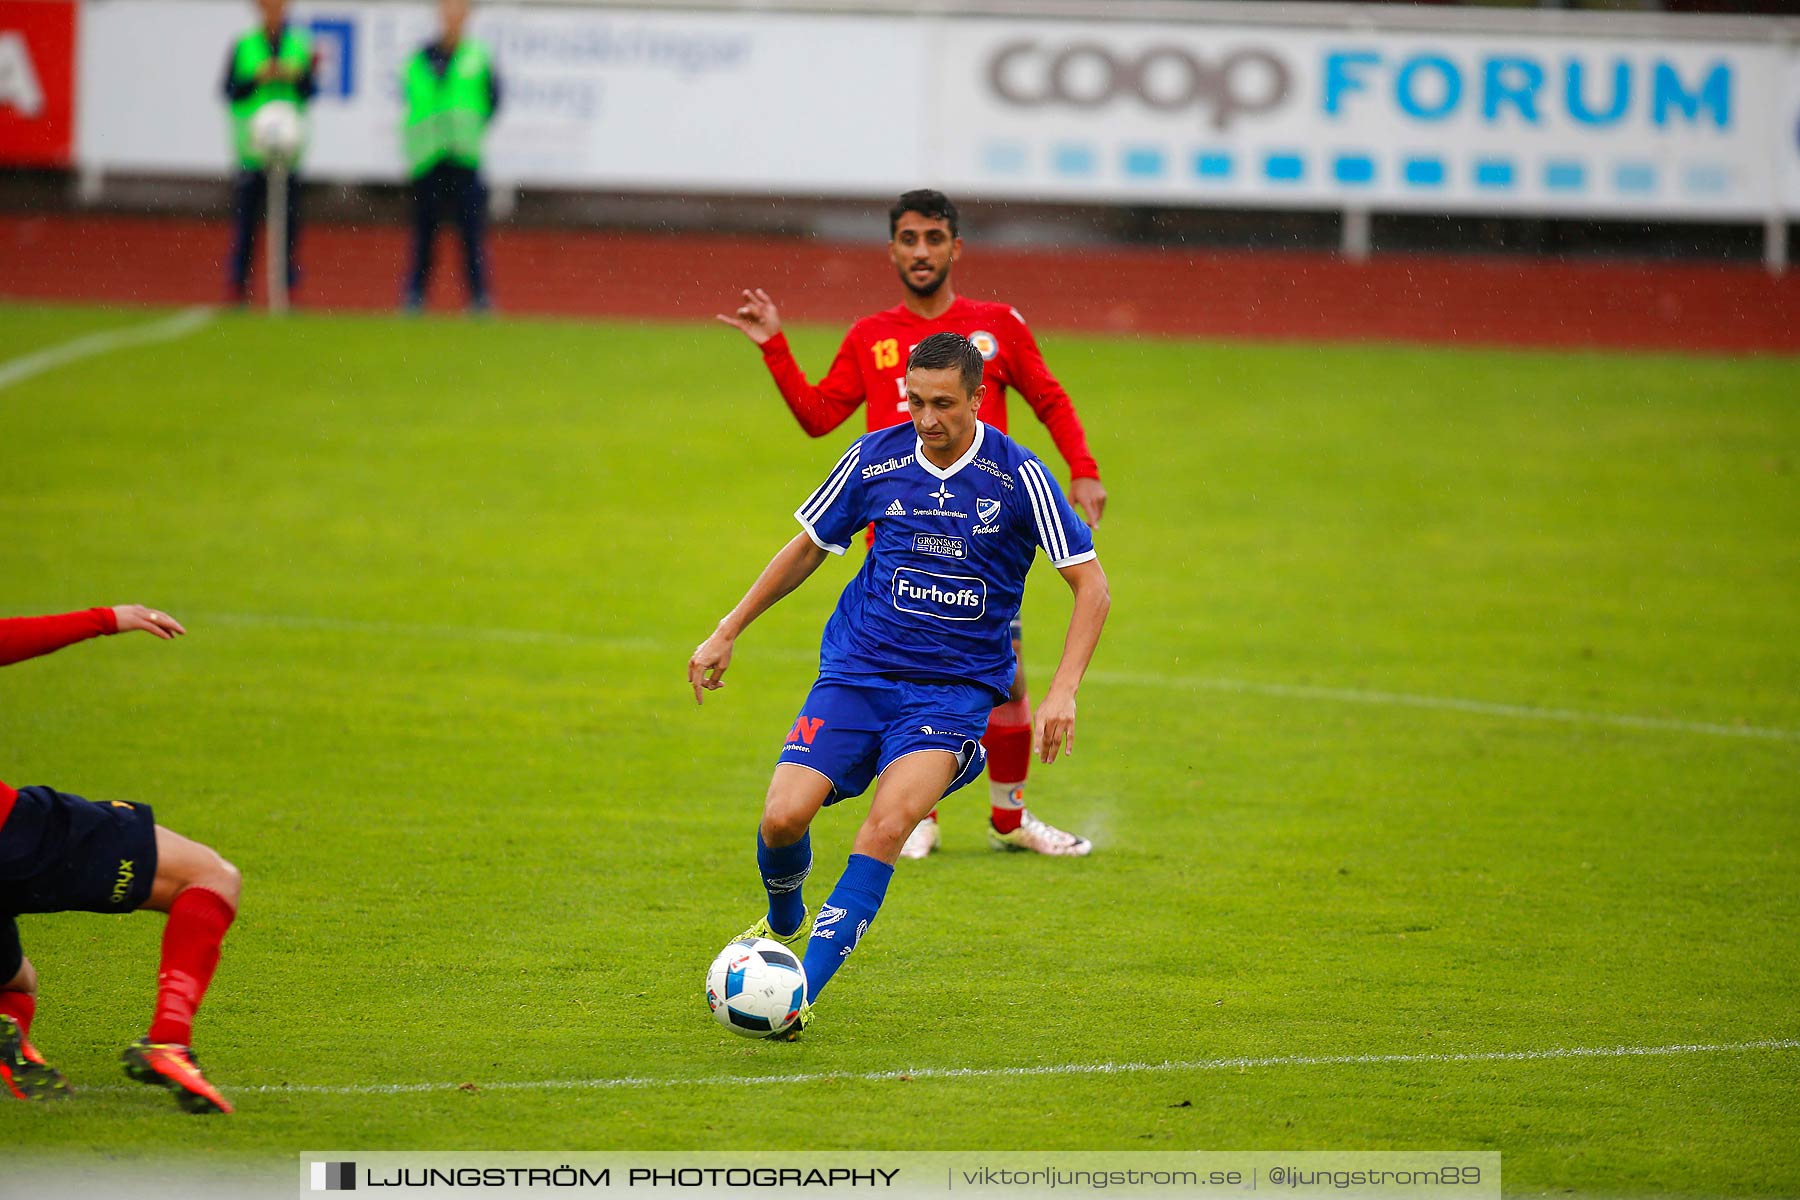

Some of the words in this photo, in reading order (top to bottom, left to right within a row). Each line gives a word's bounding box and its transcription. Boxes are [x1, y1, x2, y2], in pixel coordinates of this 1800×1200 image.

[986, 40, 1293, 131] coop
[1321, 49, 1733, 129] FORUM
[871, 338, 899, 370] 13
[861, 453, 914, 480] stadium
[972, 525, 1000, 537] Fotboll
[928, 545, 956, 556] HUSET
[897, 579, 979, 607] Furhoffs
[111, 859, 134, 903] onyx
